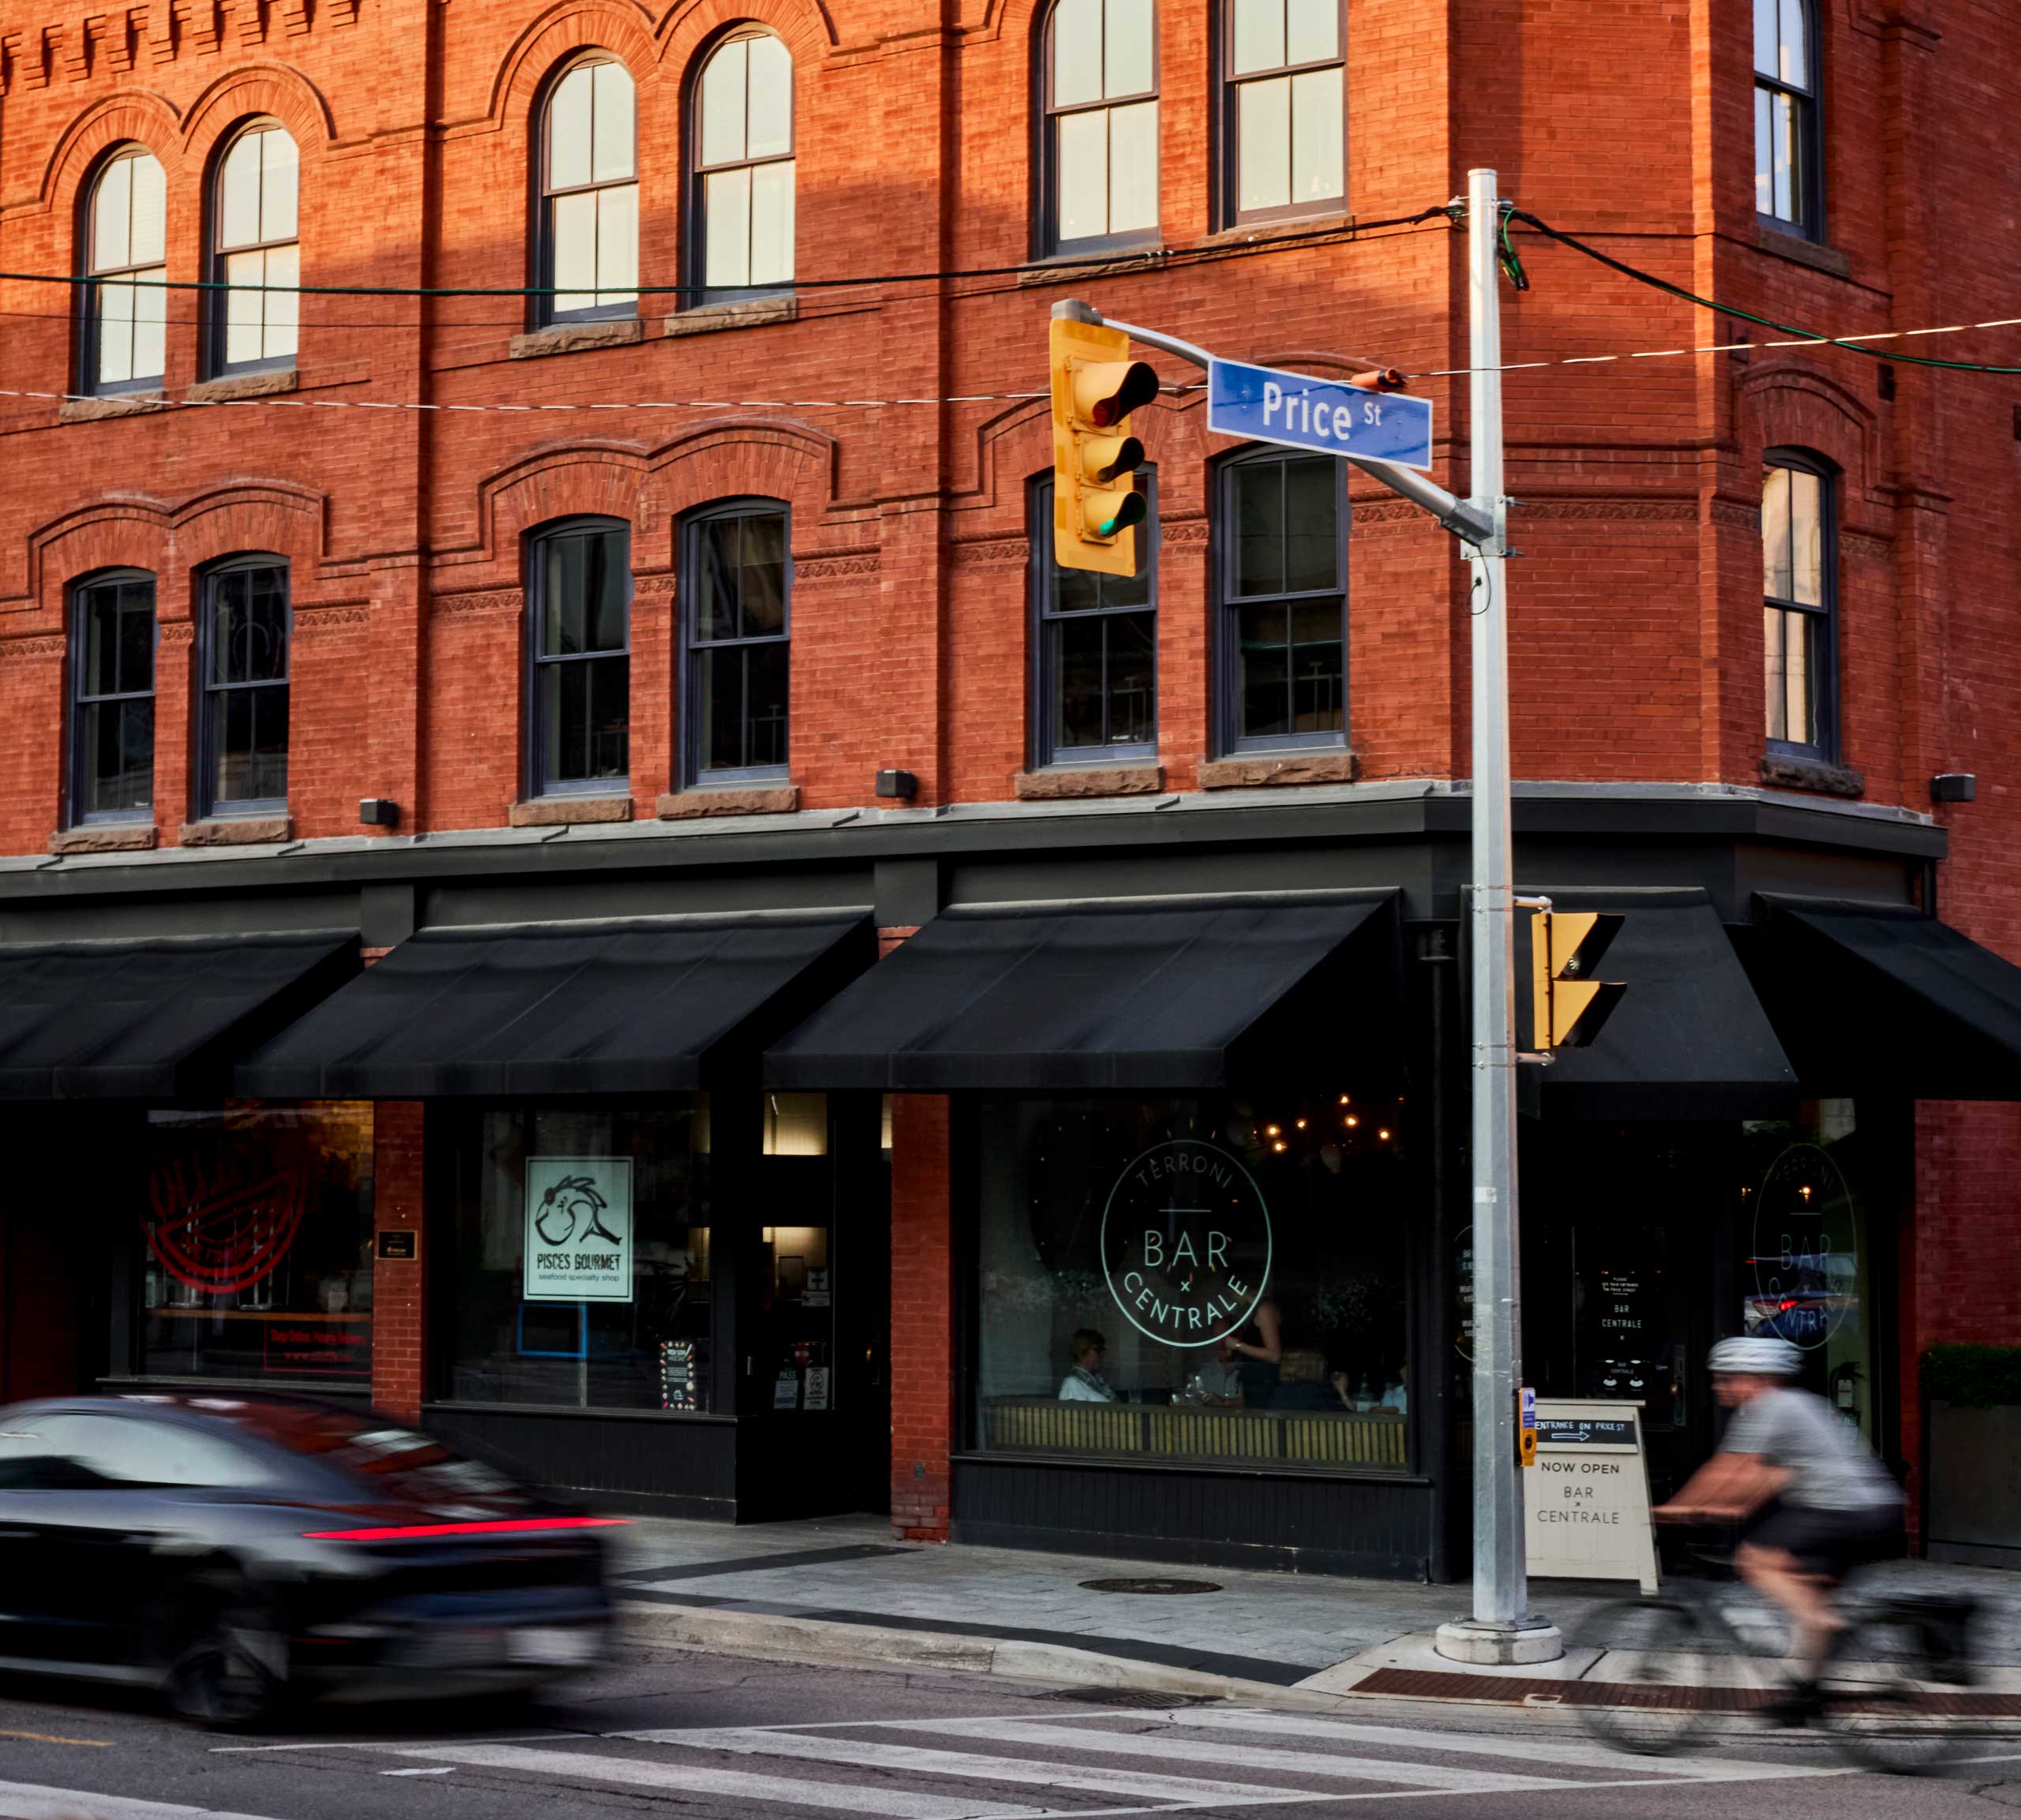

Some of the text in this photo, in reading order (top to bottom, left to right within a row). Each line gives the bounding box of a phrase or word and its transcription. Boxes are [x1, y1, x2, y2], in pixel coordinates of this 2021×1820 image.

[1263, 382, 1382, 440] Price St
[1135, 1154, 1233, 1189] TERRONI
[1145, 1230, 1228, 1268] BAR
[1780, 1233, 1832, 1271] BAR
[537, 1253, 621, 1271] PISCES GOURMET
[569, 1274, 599, 1283] specialty
[602, 1274, 620, 1283] shop
[1123, 1271, 1248, 1329] CENTRALE
[1614, 1305, 1629, 1313] BAR
[1602, 1319, 1642, 1328] CENTRALE
[1535, 1421, 1574, 1430] ENTRANCE
[1595, 1422, 1615, 1431] PRICE
[1541, 1462, 1620, 1474] NOW OPEN
[1563, 1486, 1594, 1499] BAR
[1536, 1510, 1620, 1525] CENTRALE
